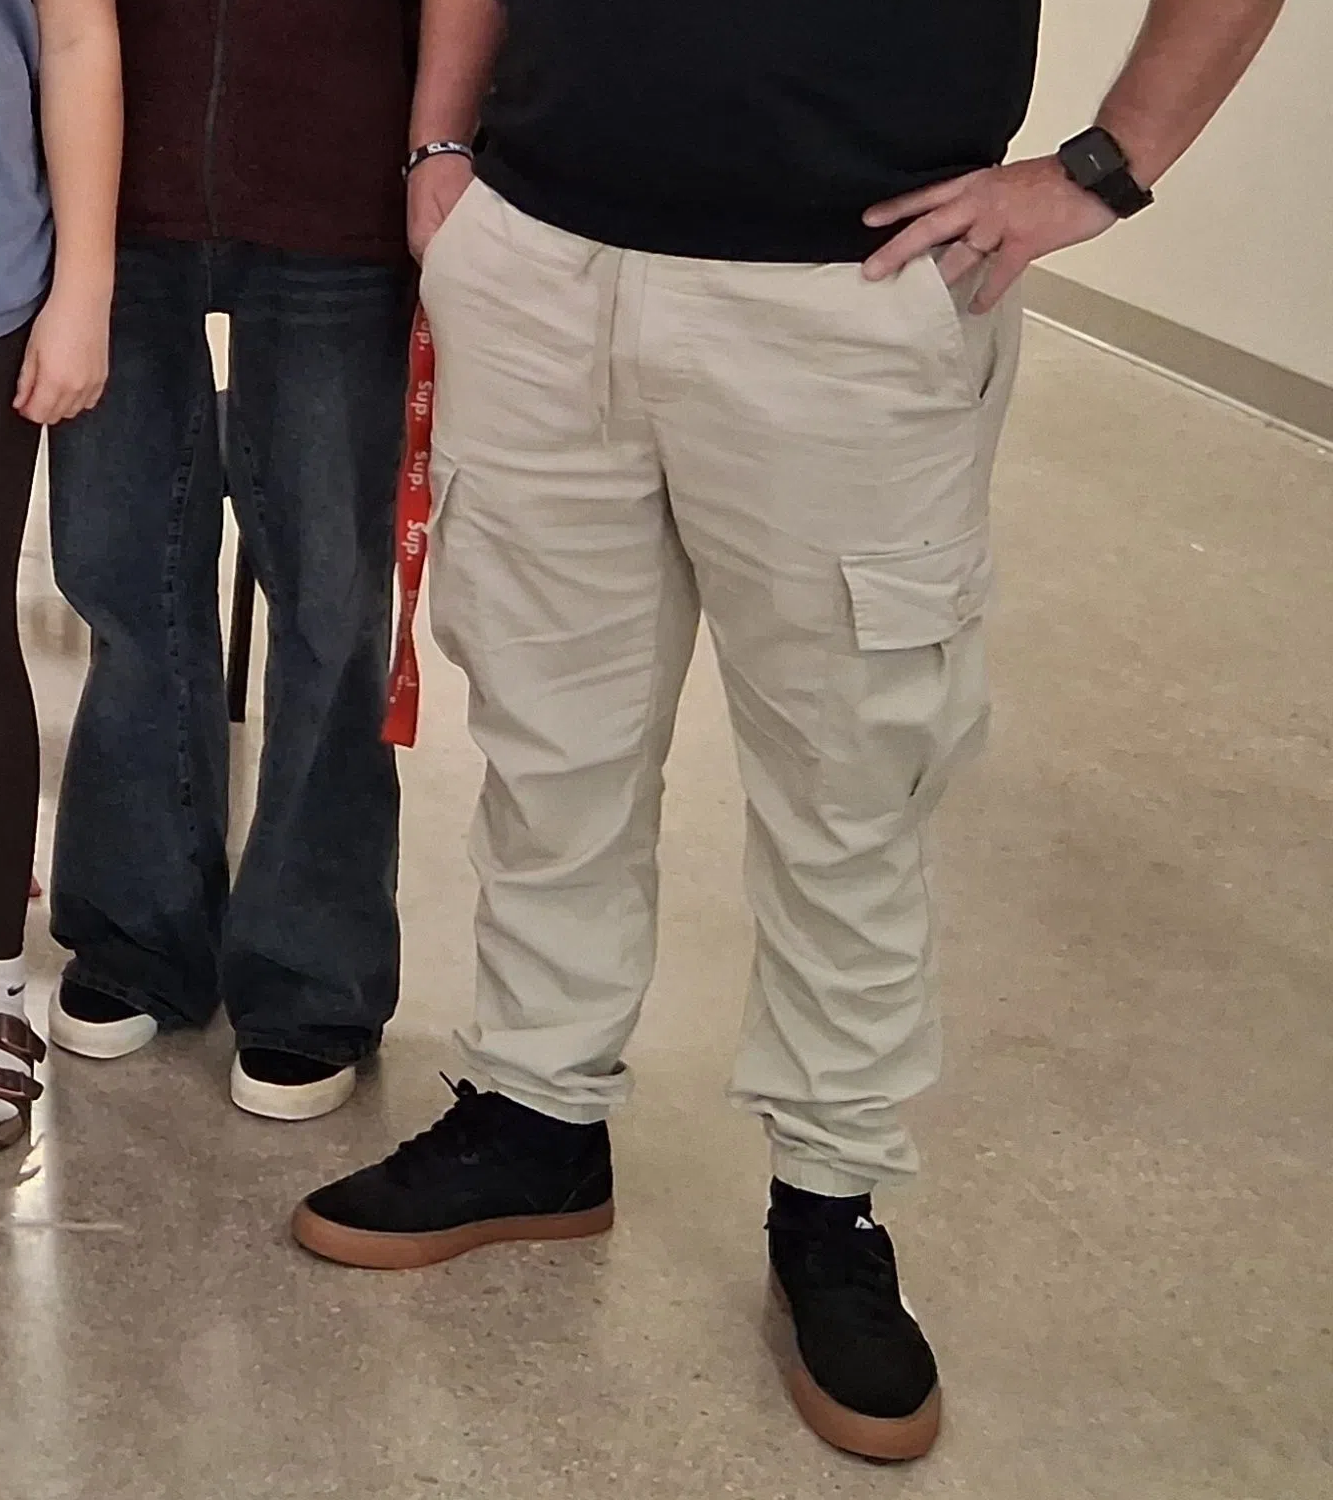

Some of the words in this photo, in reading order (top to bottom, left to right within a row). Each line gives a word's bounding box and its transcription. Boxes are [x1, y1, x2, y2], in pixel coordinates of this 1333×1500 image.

[410, 380, 433, 422] Sup.
[407, 450, 428, 492] Sup.
[401, 519, 426, 561] Sup.
